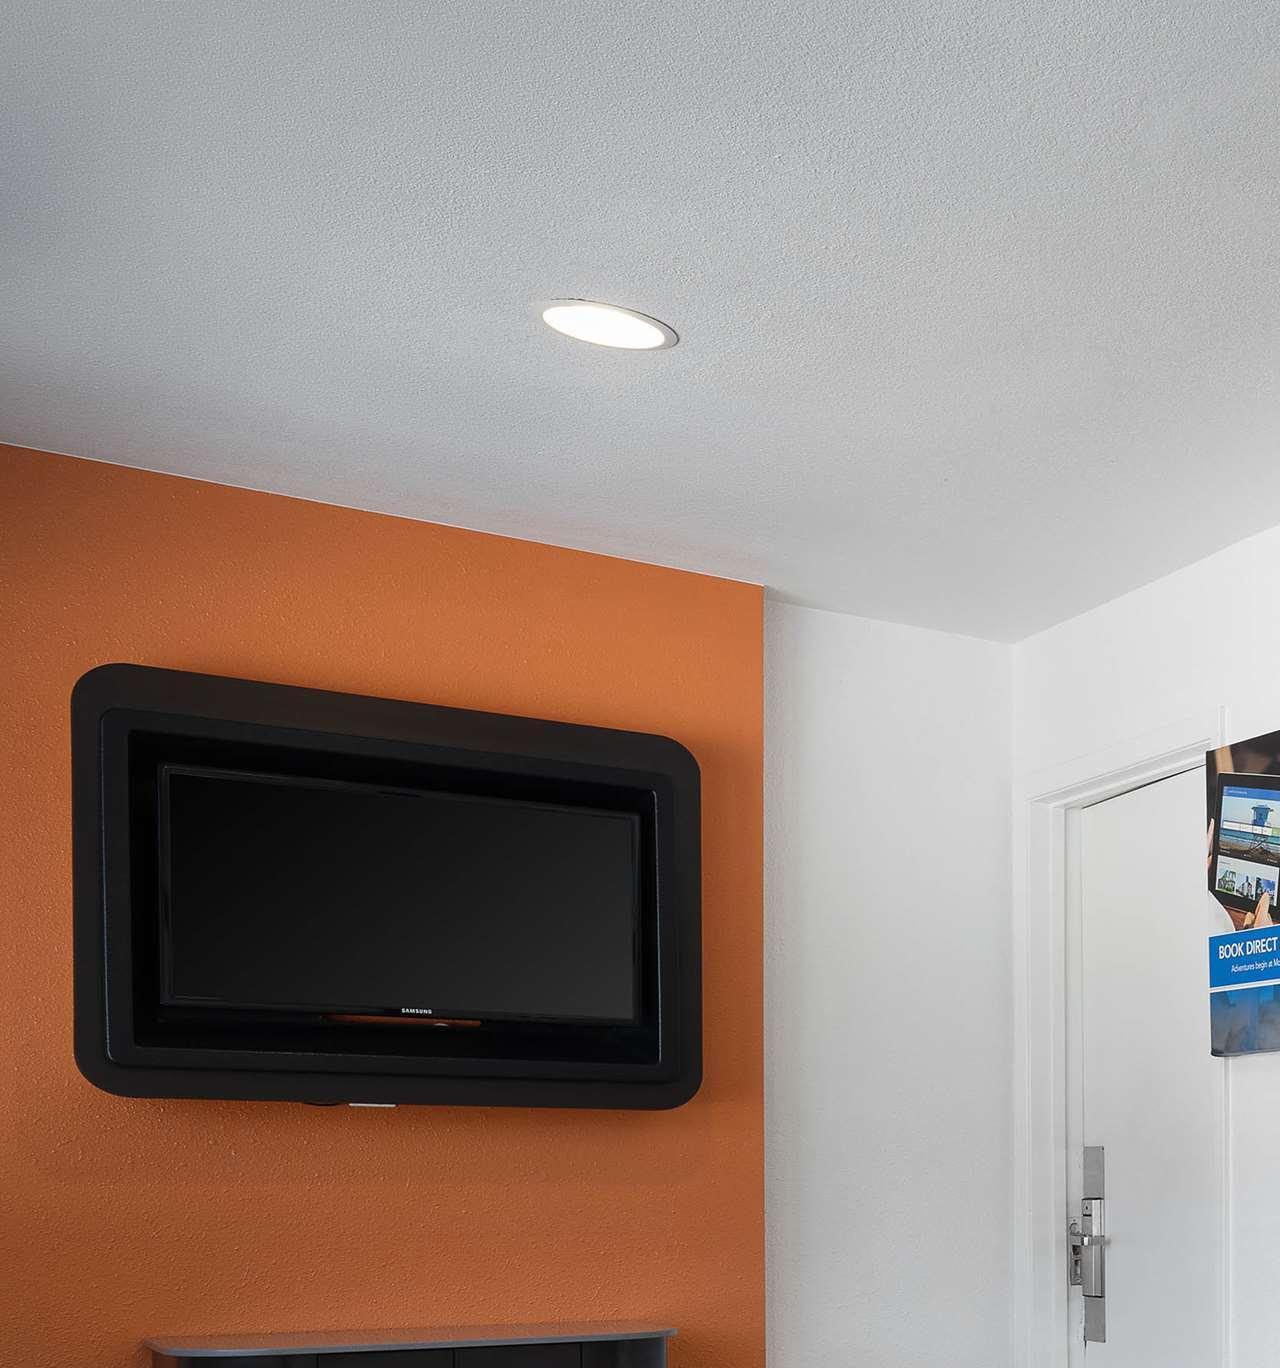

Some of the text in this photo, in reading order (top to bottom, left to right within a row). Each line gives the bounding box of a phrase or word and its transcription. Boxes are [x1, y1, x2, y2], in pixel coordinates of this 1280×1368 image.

[1218, 942, 1245, 959] BOOK
[1246, 936, 1278, 955] DIRECT
[1255, 960, 1269, 972] begin
